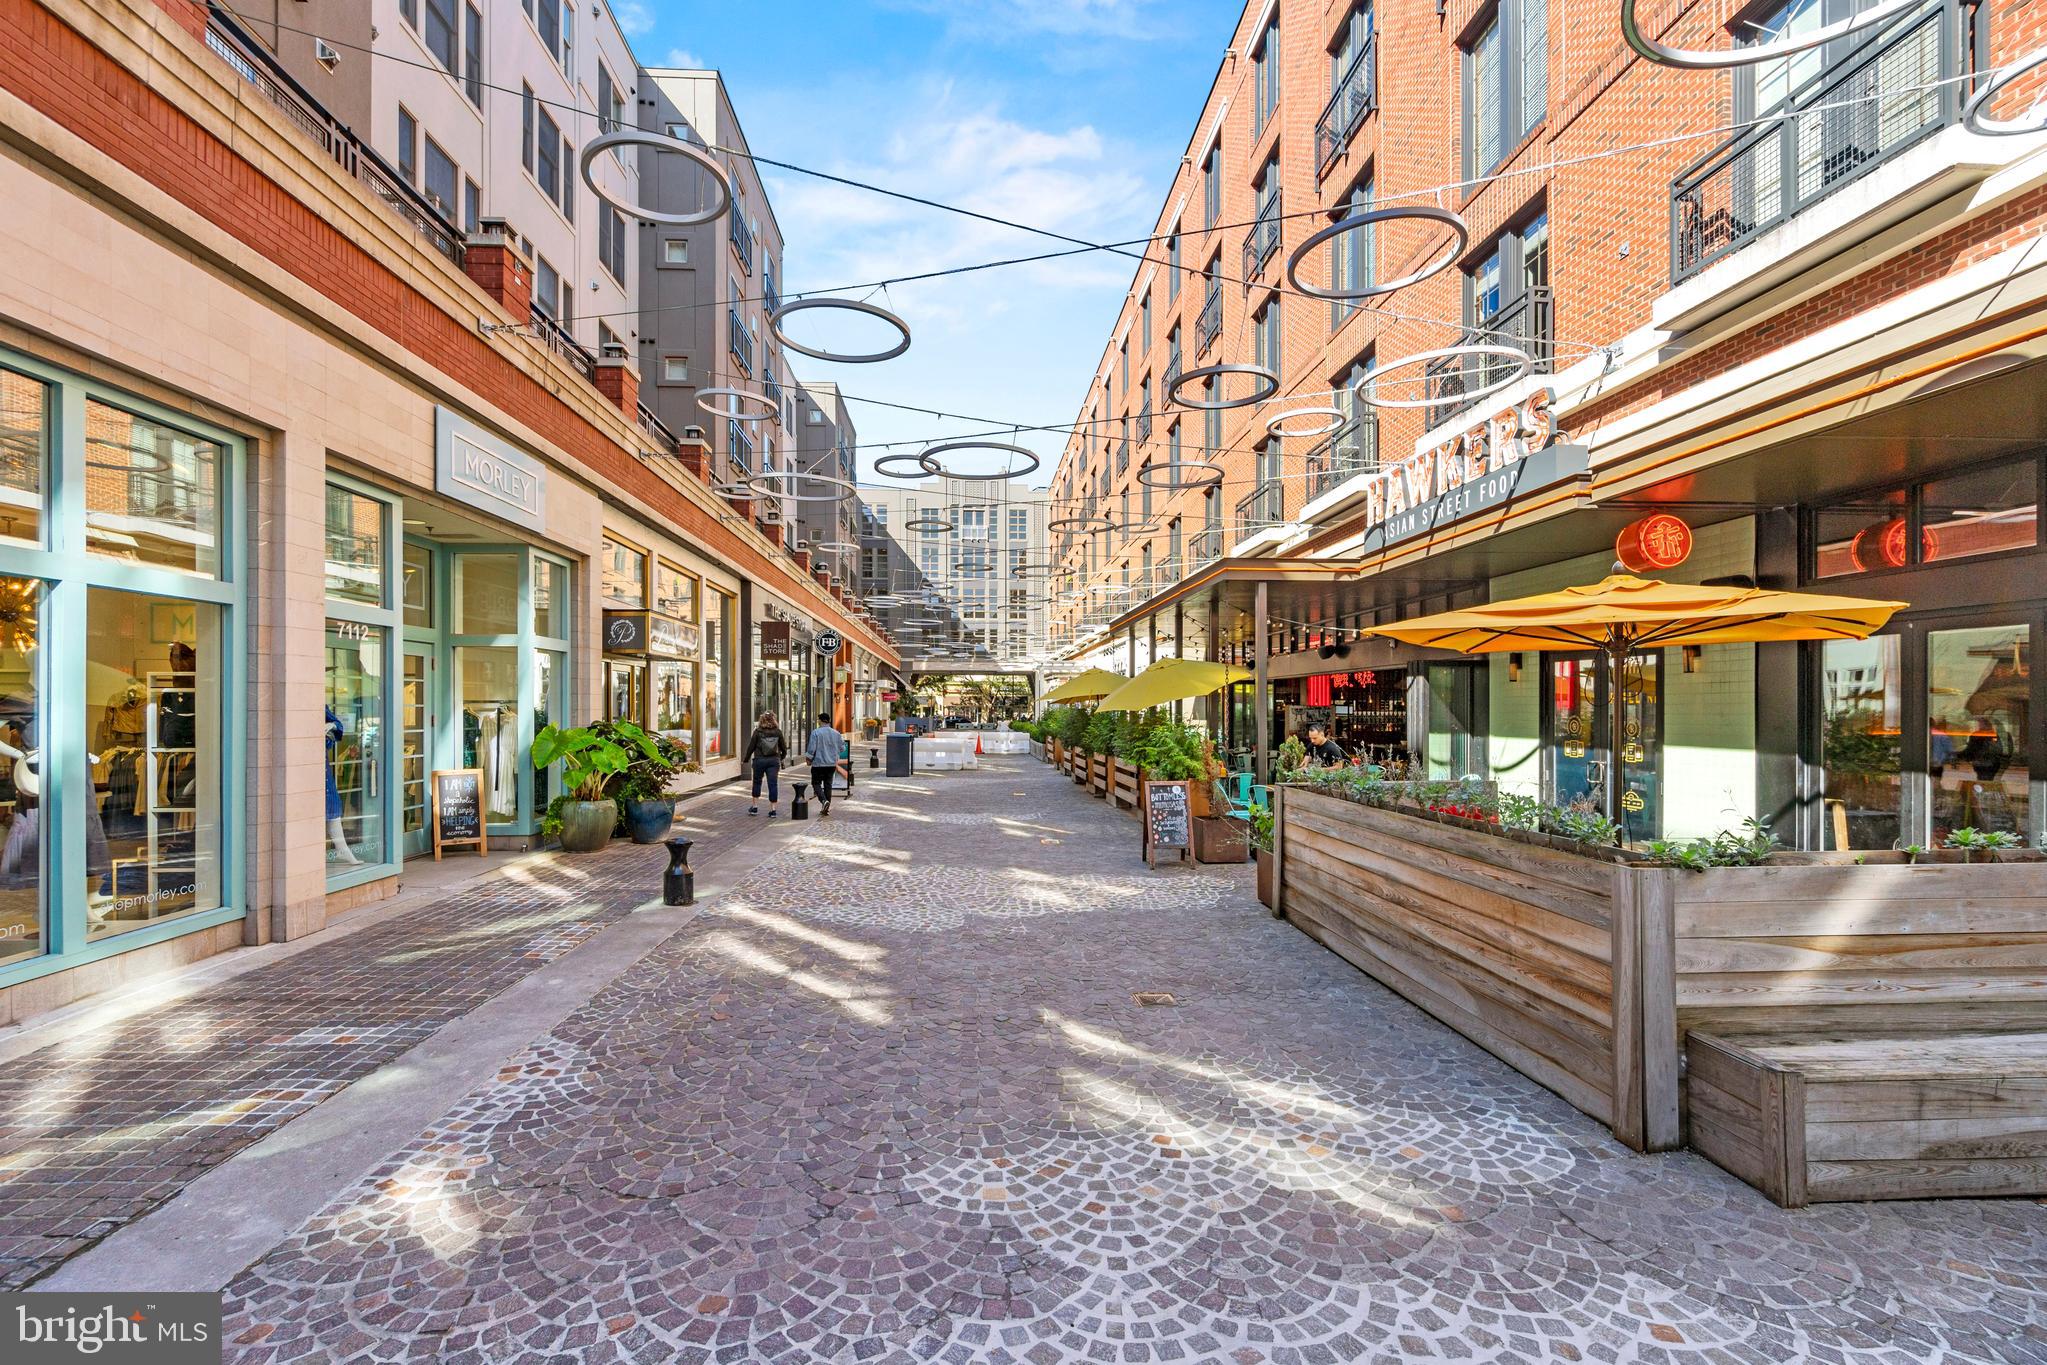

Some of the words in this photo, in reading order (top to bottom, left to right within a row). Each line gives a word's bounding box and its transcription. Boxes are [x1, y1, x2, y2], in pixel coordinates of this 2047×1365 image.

[464, 448, 530, 502] MORLEY
[1366, 387, 1554, 527] HAWKERS
[1422, 490, 1471, 525] STREET
[1480, 471, 1518, 502] FOOD
[336, 622, 369, 641] 7112
[445, 816, 475, 827] HELPING
[100, 880, 207, 914] shopmorley.com
